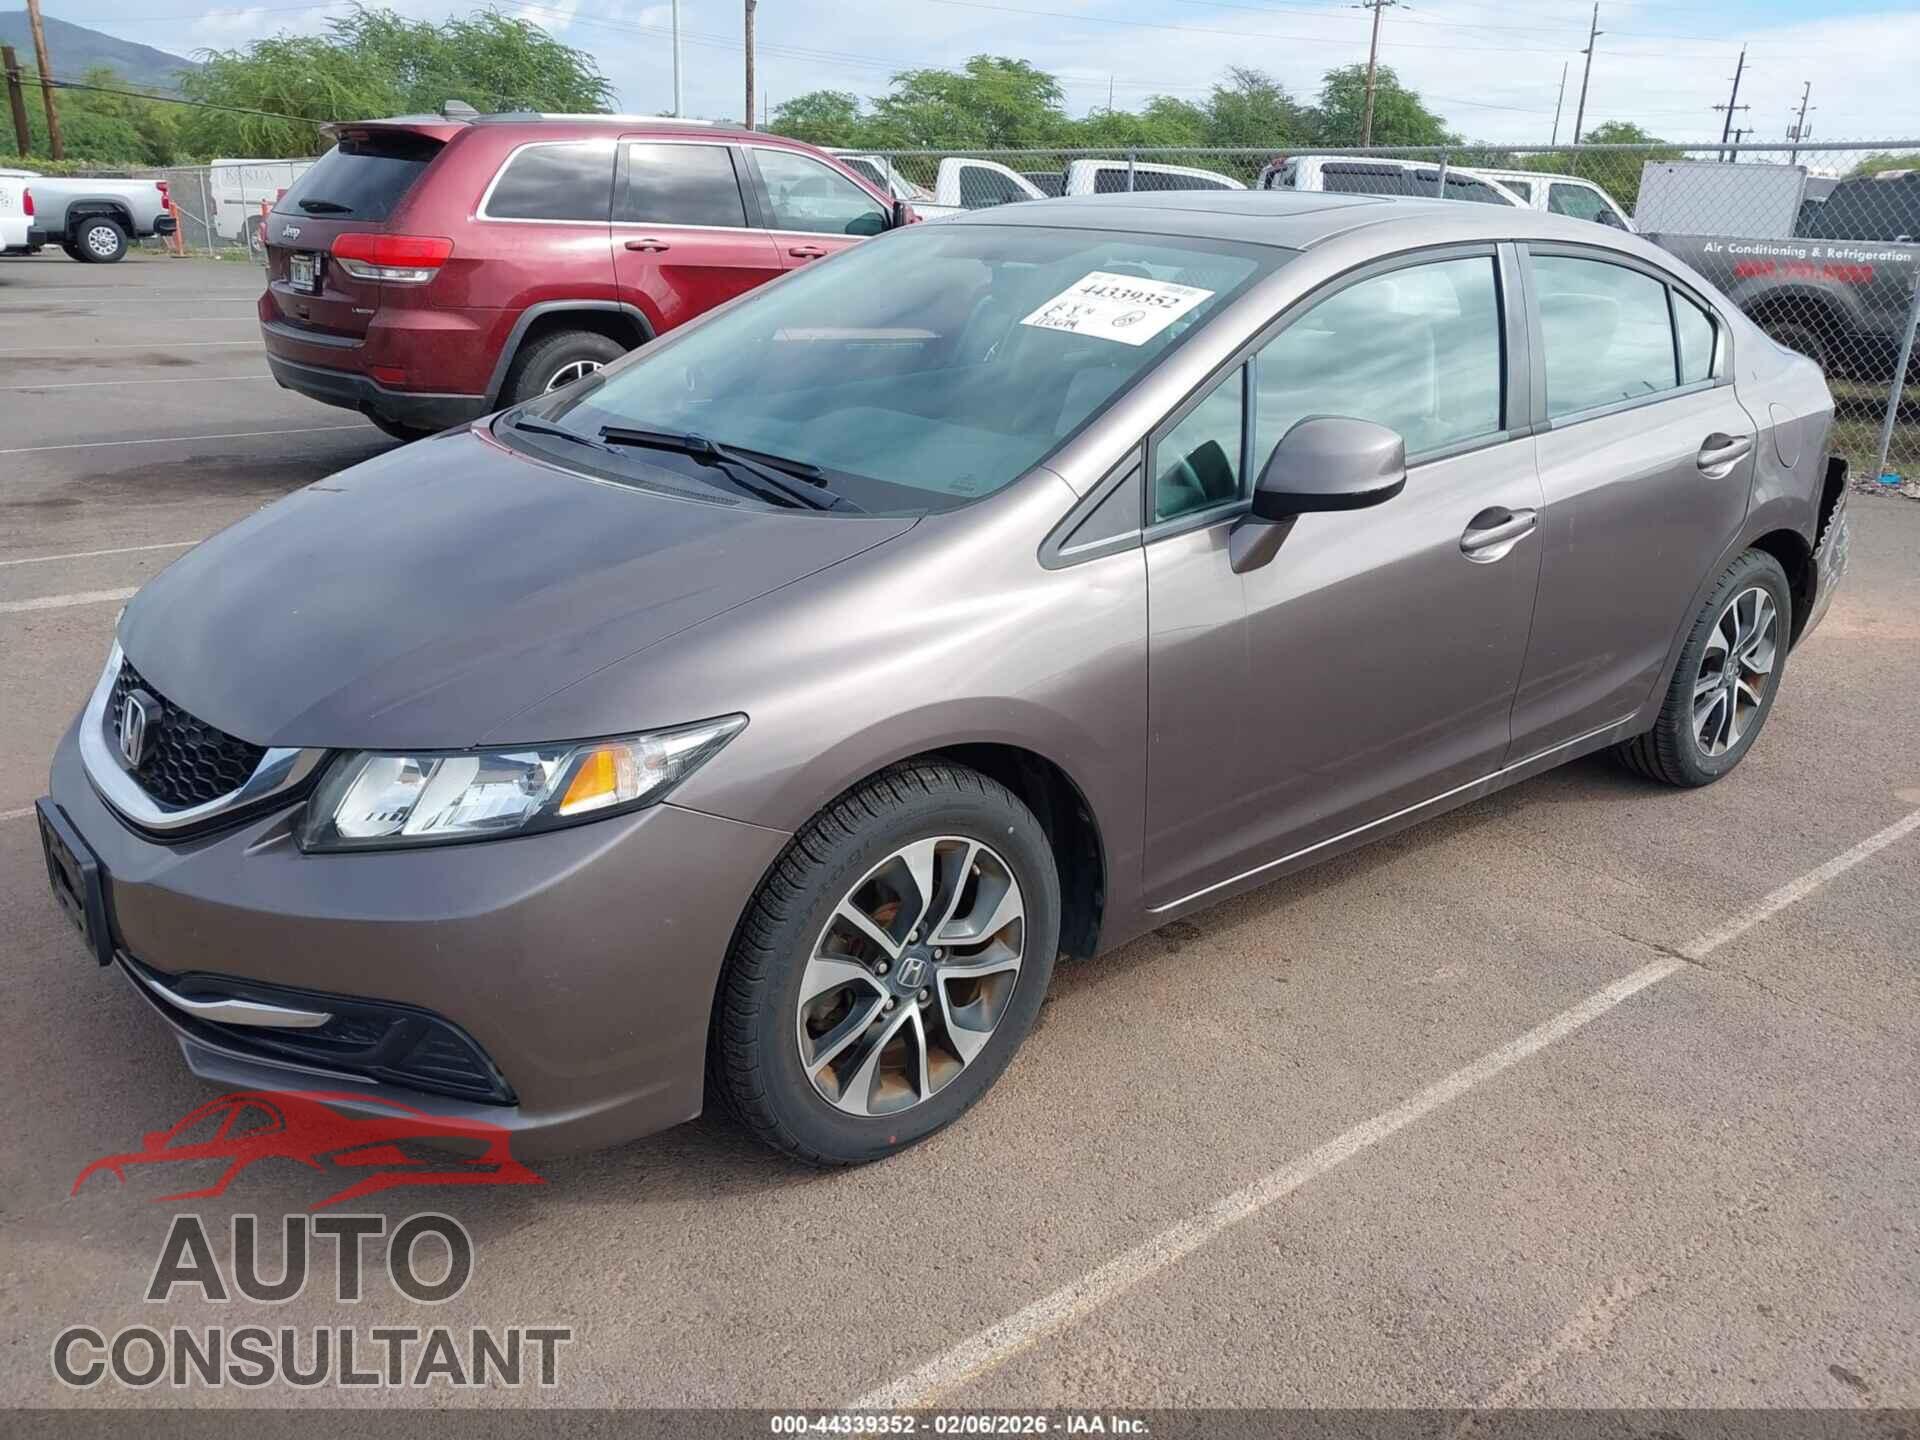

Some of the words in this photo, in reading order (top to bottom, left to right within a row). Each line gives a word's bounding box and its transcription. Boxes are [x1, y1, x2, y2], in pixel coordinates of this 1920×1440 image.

[282, 224, 301, 240] Jeep
[1703, 242, 1723, 253] Air
[1728, 243, 1806, 260] Conditioning
[1811, 248, 1821, 257] &
[1826, 248, 1912, 263] Refrigeration
[1080, 284, 1181, 309] 44339352
